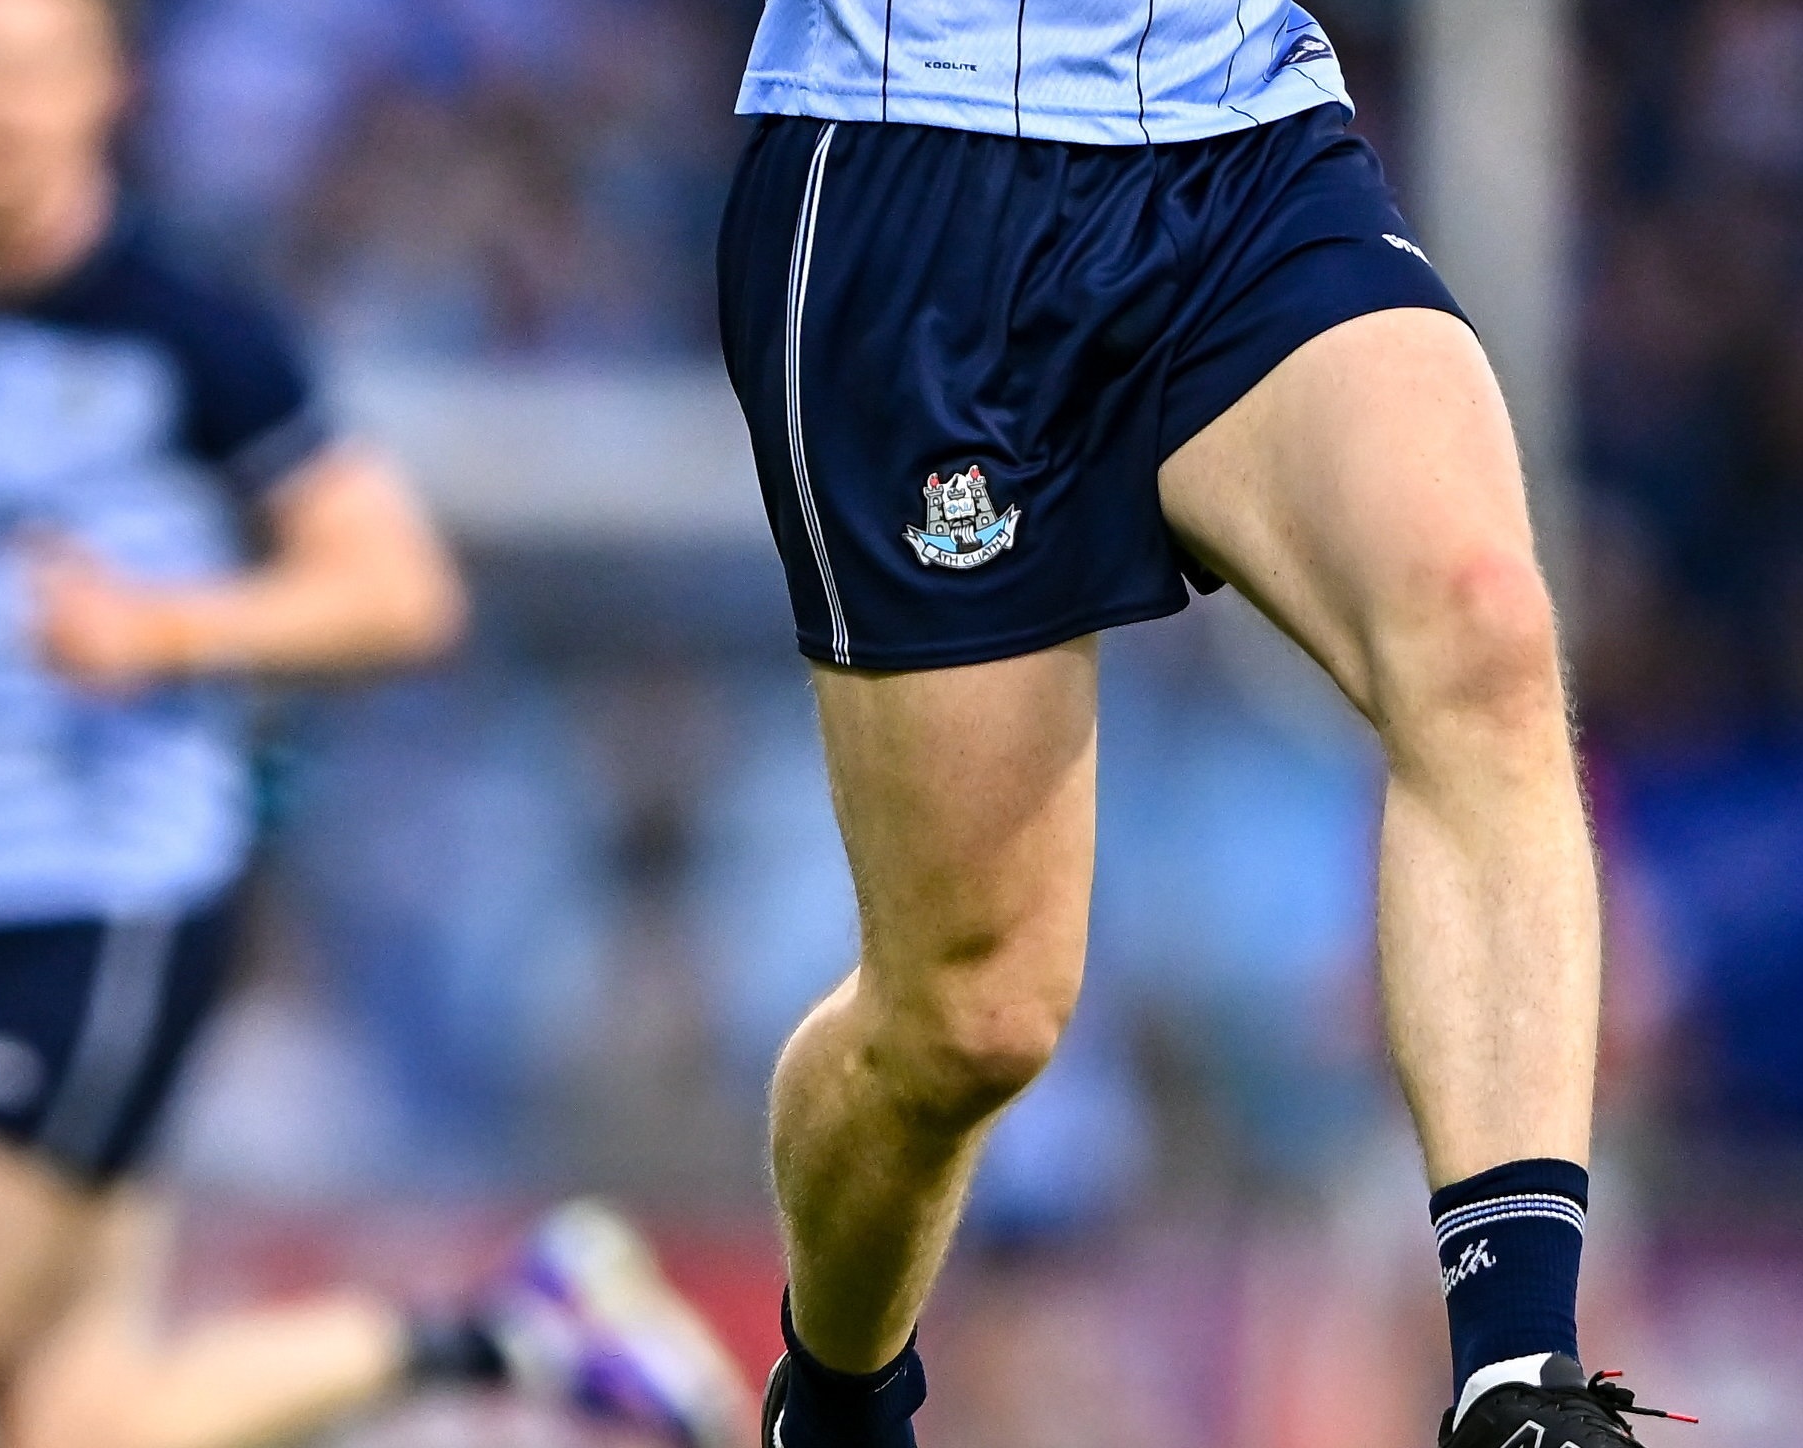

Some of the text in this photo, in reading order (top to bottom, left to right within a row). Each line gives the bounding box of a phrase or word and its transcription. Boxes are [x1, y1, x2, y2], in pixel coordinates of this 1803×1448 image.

[924, 61, 977, 72] KOOLITE
[933, 539, 1002, 565] ATH CLIATH
